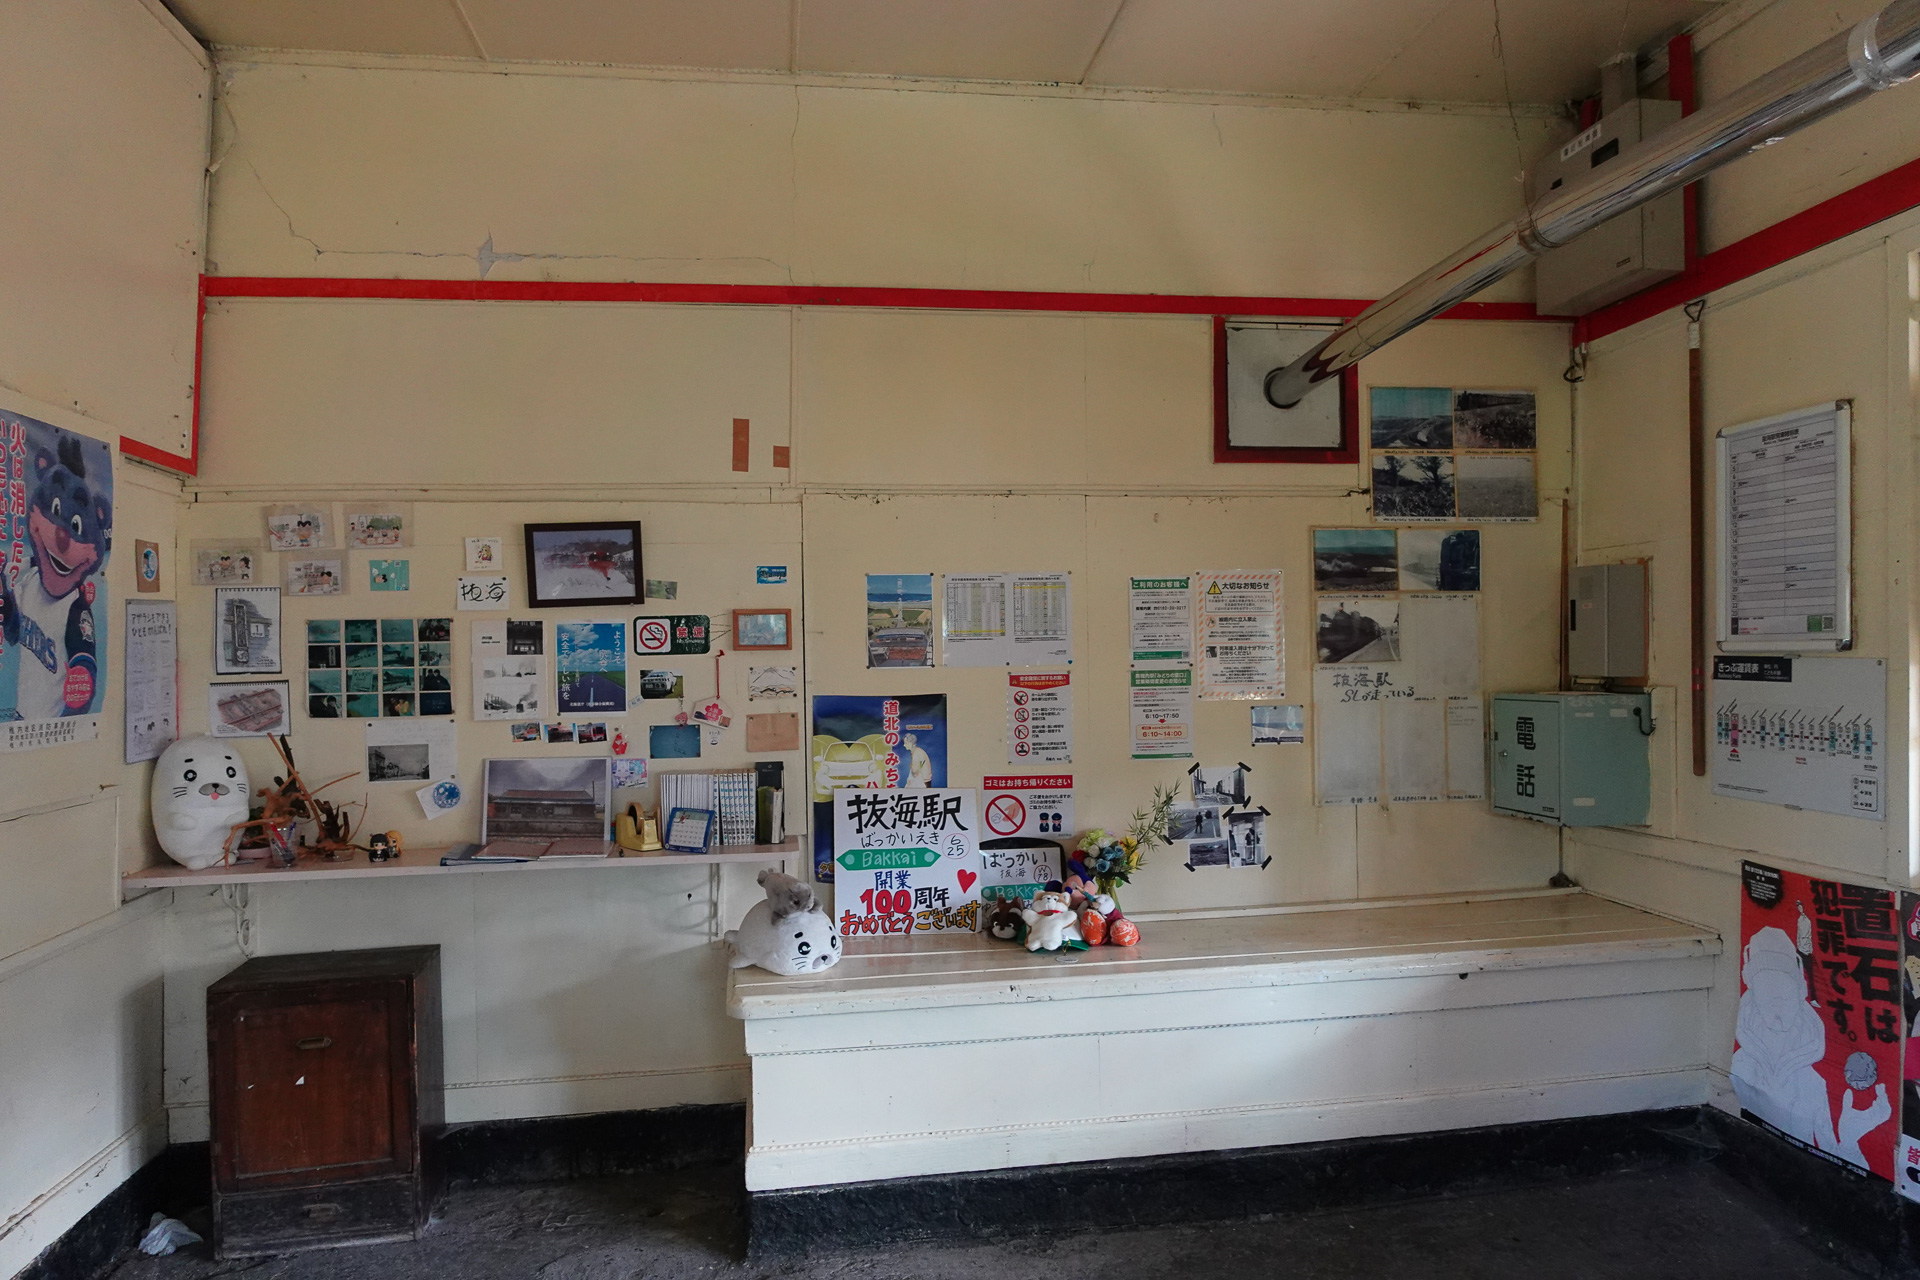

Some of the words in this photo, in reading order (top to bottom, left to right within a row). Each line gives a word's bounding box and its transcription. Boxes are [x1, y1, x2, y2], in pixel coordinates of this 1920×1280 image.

[676, 626, 704, 638] 禁煙
[1718, 662, 1759, 673] きっぷ運賃表
[884, 700, 899, 745] 道北の
[1516, 716, 1536, 798] 電話
[884, 753, 899, 789] みち
[985, 778, 1071, 787] ゴミはお持ち帰りください
[847, 793, 969, 834] 抜海駅
[861, 831, 940, 848] ばっかいえき
[950, 835, 961, 845] 6
[947, 845, 964, 856] 25
[983, 852, 1047, 870] ばっかい
[875, 870, 912, 891] 開業
[1000, 867, 1027, 879] 抜海
[840, 909, 915, 935] おめでとう
[915, 900, 981, 932] ございます
[1810, 880, 1857, 1042] 犯罪です。
[1839, 883, 1901, 1044] 置石は
